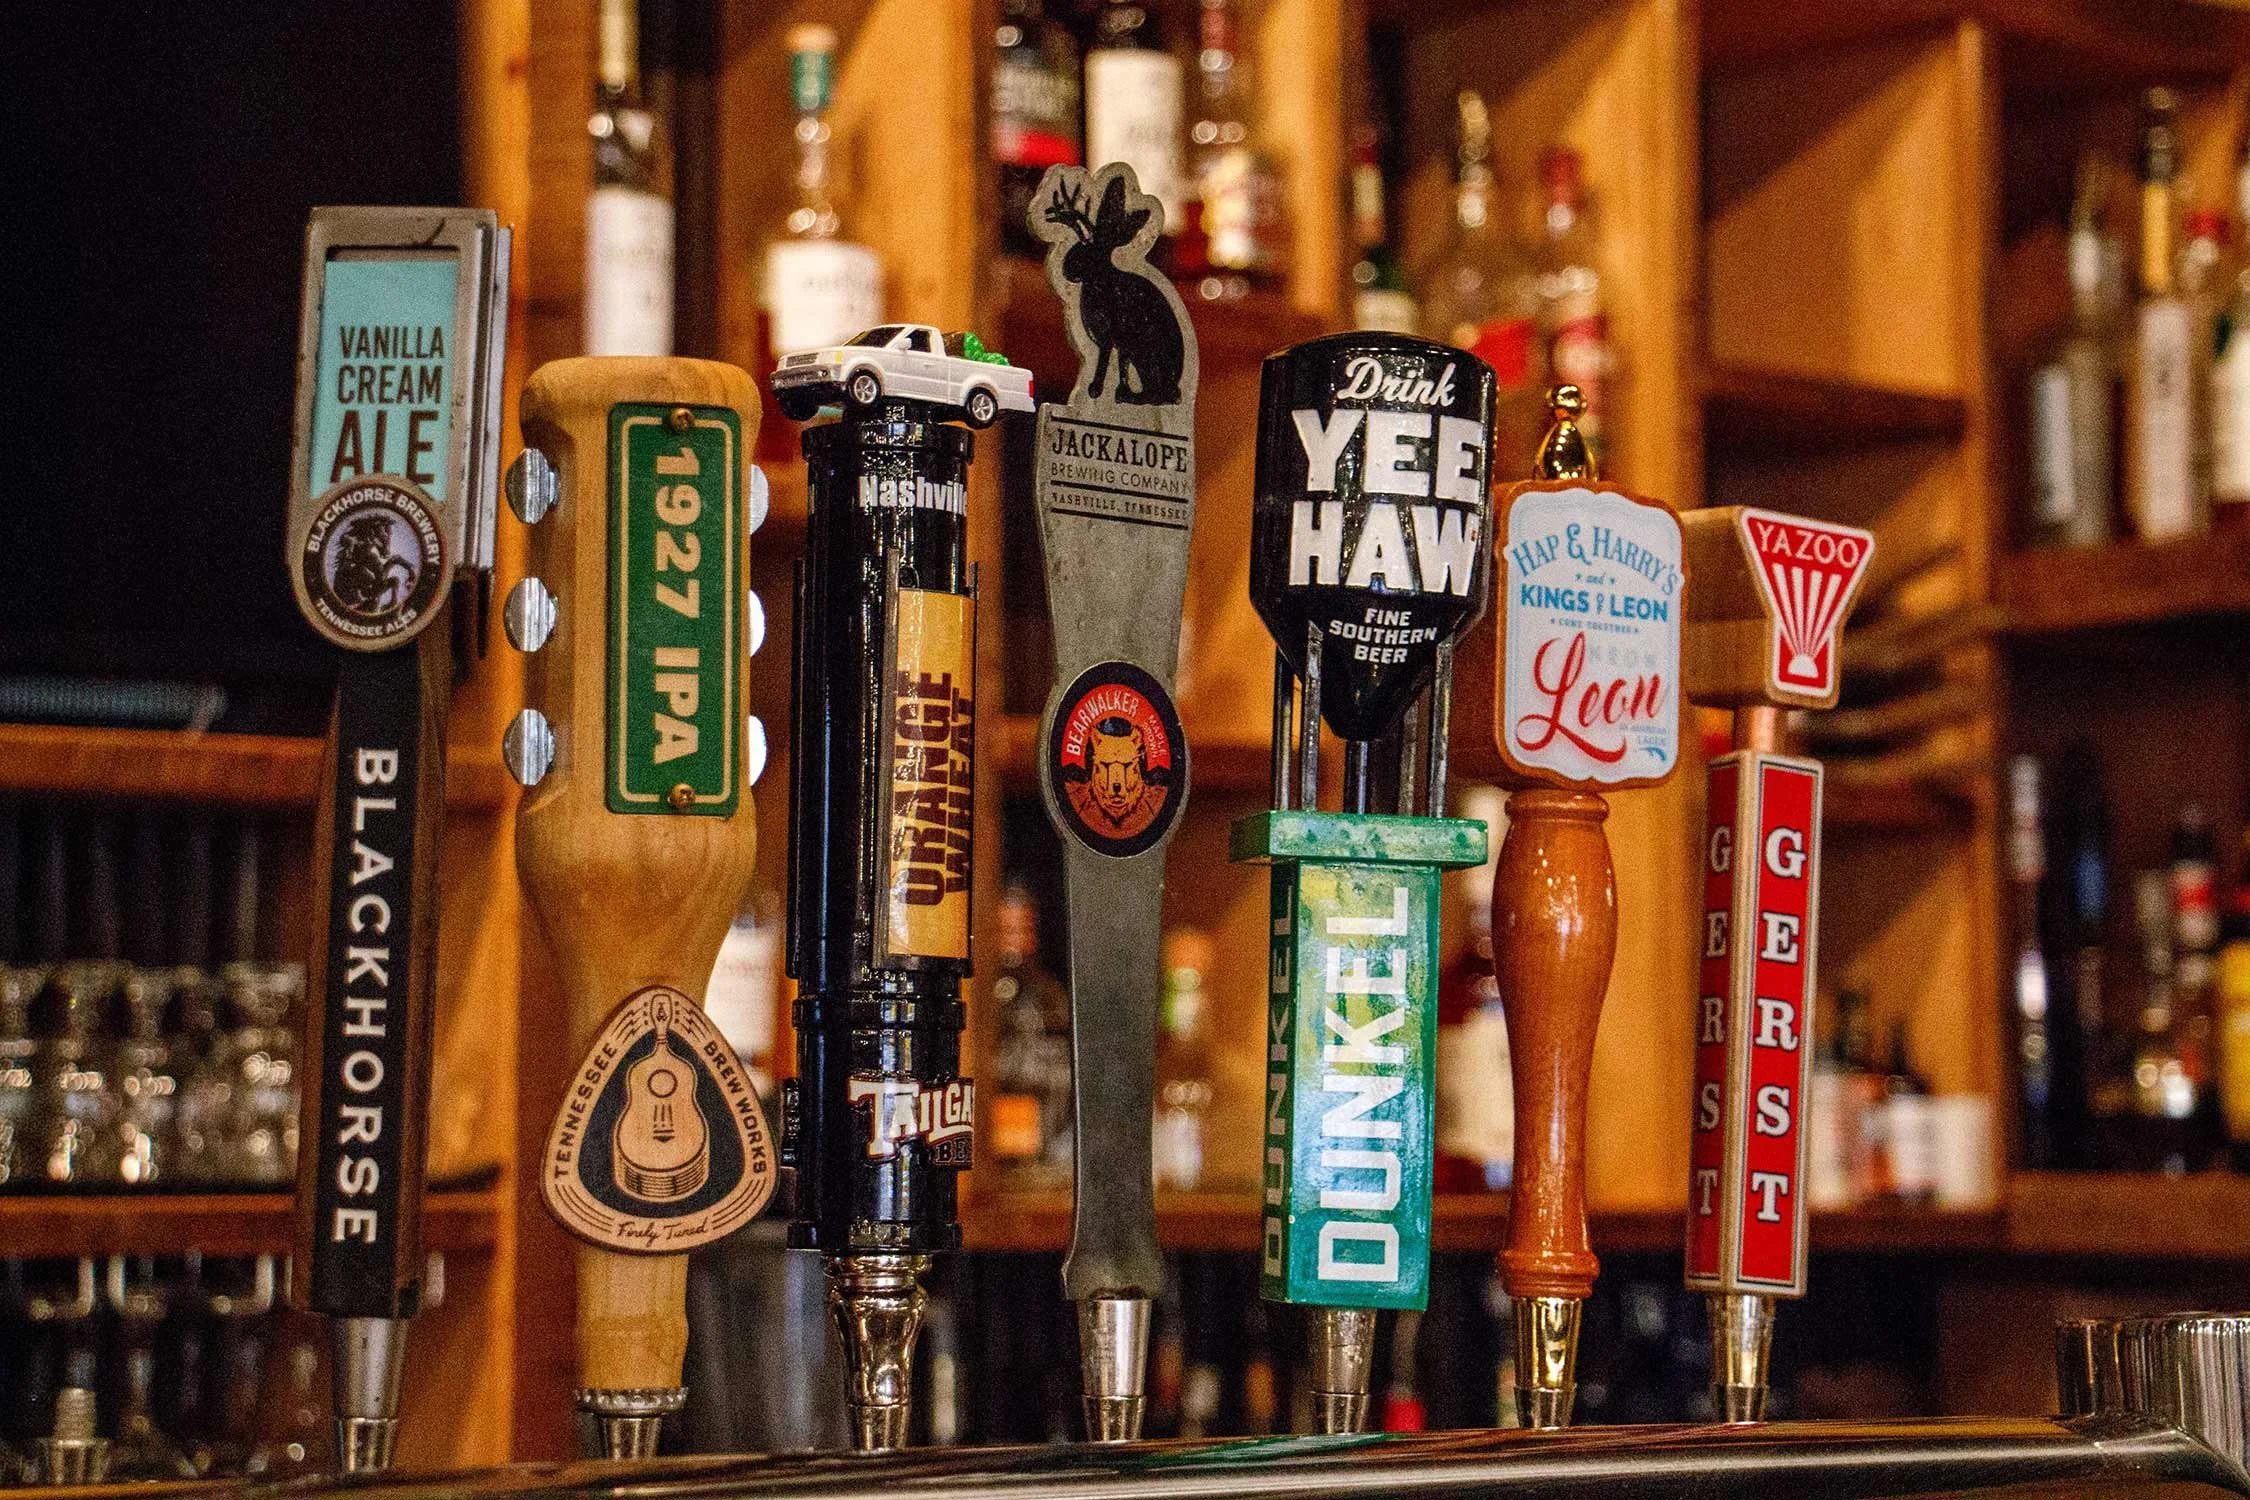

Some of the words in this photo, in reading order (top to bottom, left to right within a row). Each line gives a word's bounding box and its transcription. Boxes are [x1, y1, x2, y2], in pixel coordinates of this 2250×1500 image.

[340, 325, 444, 360] VANILLA
[338, 365, 442, 404] CREAM
[1337, 357, 1456, 407] Drink
[329, 410, 439, 485] ALE
[1051, 462, 1115, 483] BREWING
[1121, 472, 1189, 494] COMPANY
[1052, 428, 1187, 473] JACKALOPE
[1291, 408, 1484, 504] YEE
[307, 488, 395, 552] BLACKHORSE
[396, 494, 441, 565] BREWERY
[654, 447, 701, 618] 1927
[1289, 500, 1481, 597] HAW
[1512, 534, 1560, 577] HAP
[1566, 522, 1592, 566] &
[1592, 525, 1679, 597] HARRY'S
[1757, 522, 1860, 569] YAZOO
[316, 598, 384, 637] TENNESSEE
[387, 609, 418, 634] ALES
[1329, 620, 1437, 645] SOUTHERN
[1364, 607, 1412, 626] FINE
[1520, 583, 1590, 613] KINGS
[1610, 593, 1668, 622] LEON
[1354, 643, 1407, 665] BEER
[653, 647, 700, 764] IPA
[1066, 689, 1139, 756] BEARWALKER
[1515, 631, 1672, 763] Leon
[893, 671, 952, 906] ORANGE
[332, 747, 399, 1243] BLACKHORSE
[1697, 825, 1731, 1216] GERST
[1752, 826, 1806, 1223] GERST
[554, 1042, 618, 1179] TENNESSEE
[704, 1039, 743, 1094] BREW
[735, 1096, 767, 1174] WORKS
[1265, 885, 1293, 1277] DUNKEL
[1318, 886, 1409, 1283] DUNKEL
[617, 1221, 660, 1248] Finely
[663, 1216, 708, 1240] Tuned
